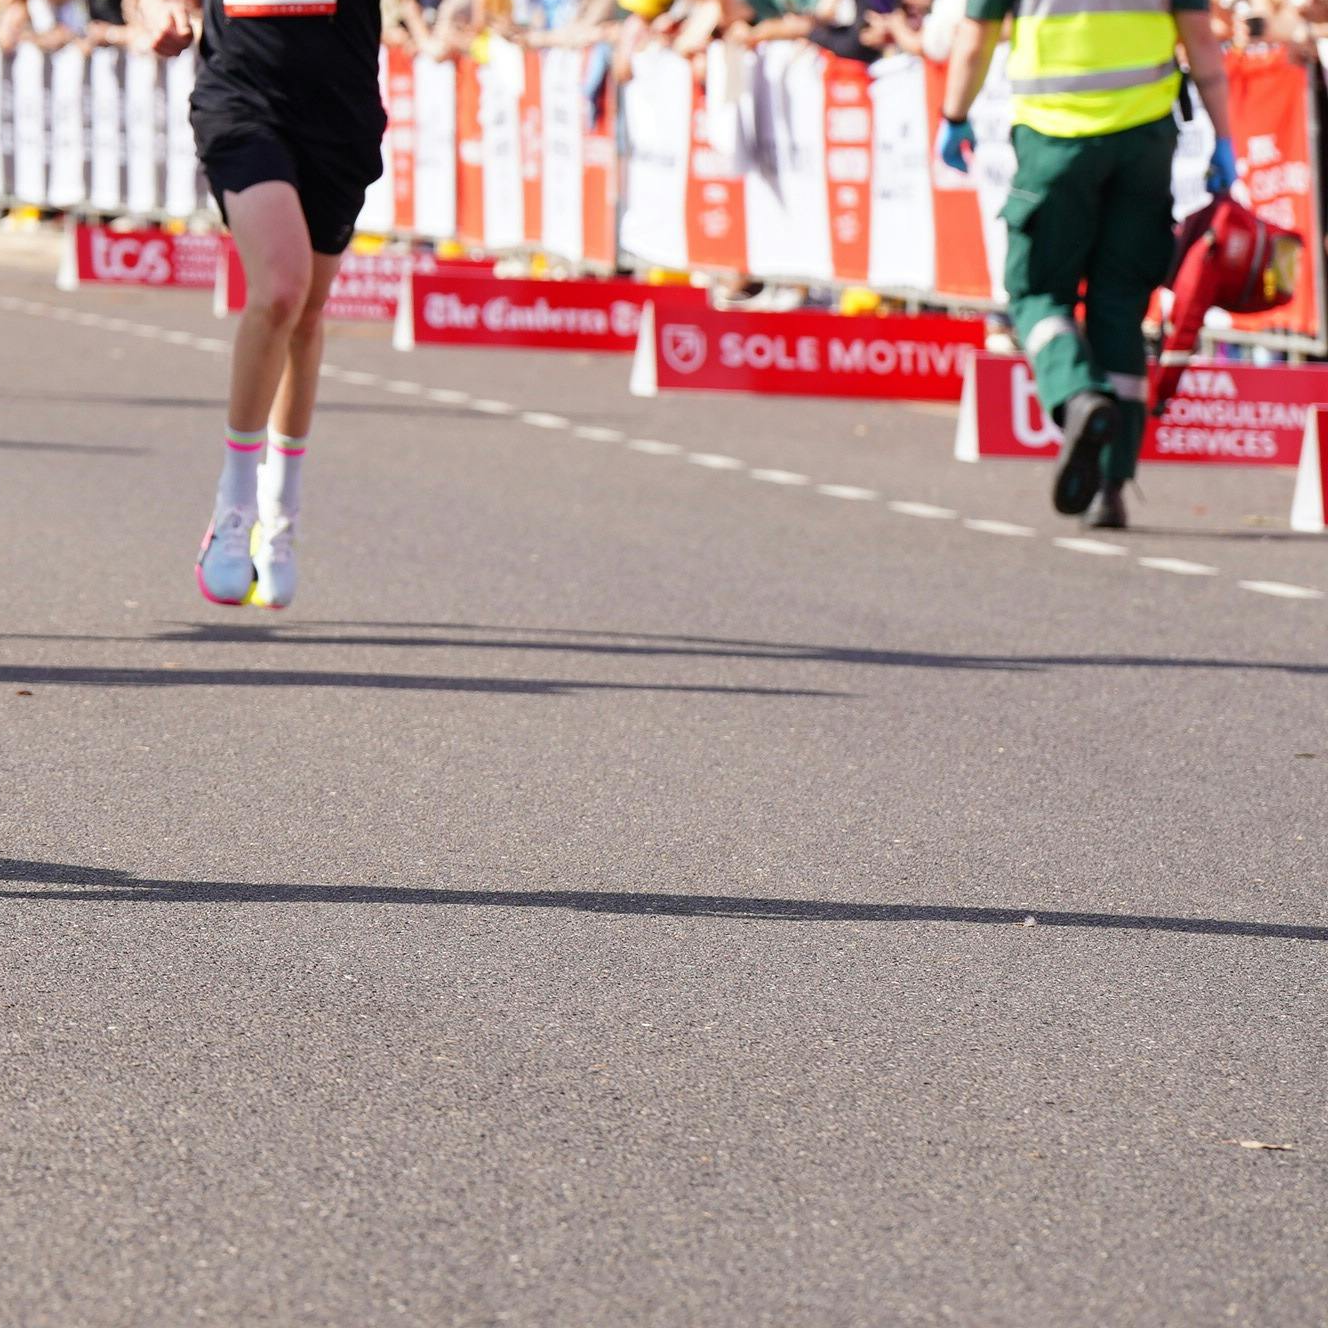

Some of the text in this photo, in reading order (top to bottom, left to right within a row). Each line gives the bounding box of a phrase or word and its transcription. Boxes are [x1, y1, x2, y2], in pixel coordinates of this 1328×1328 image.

[91, 231, 171, 283] tcs
[424, 292, 478, 329] The
[482, 294, 608, 334] Canberra
[719, 332, 821, 369] SOLE
[1176, 369, 1237, 398] ATA
[1155, 429, 1278, 457] SERVICES
